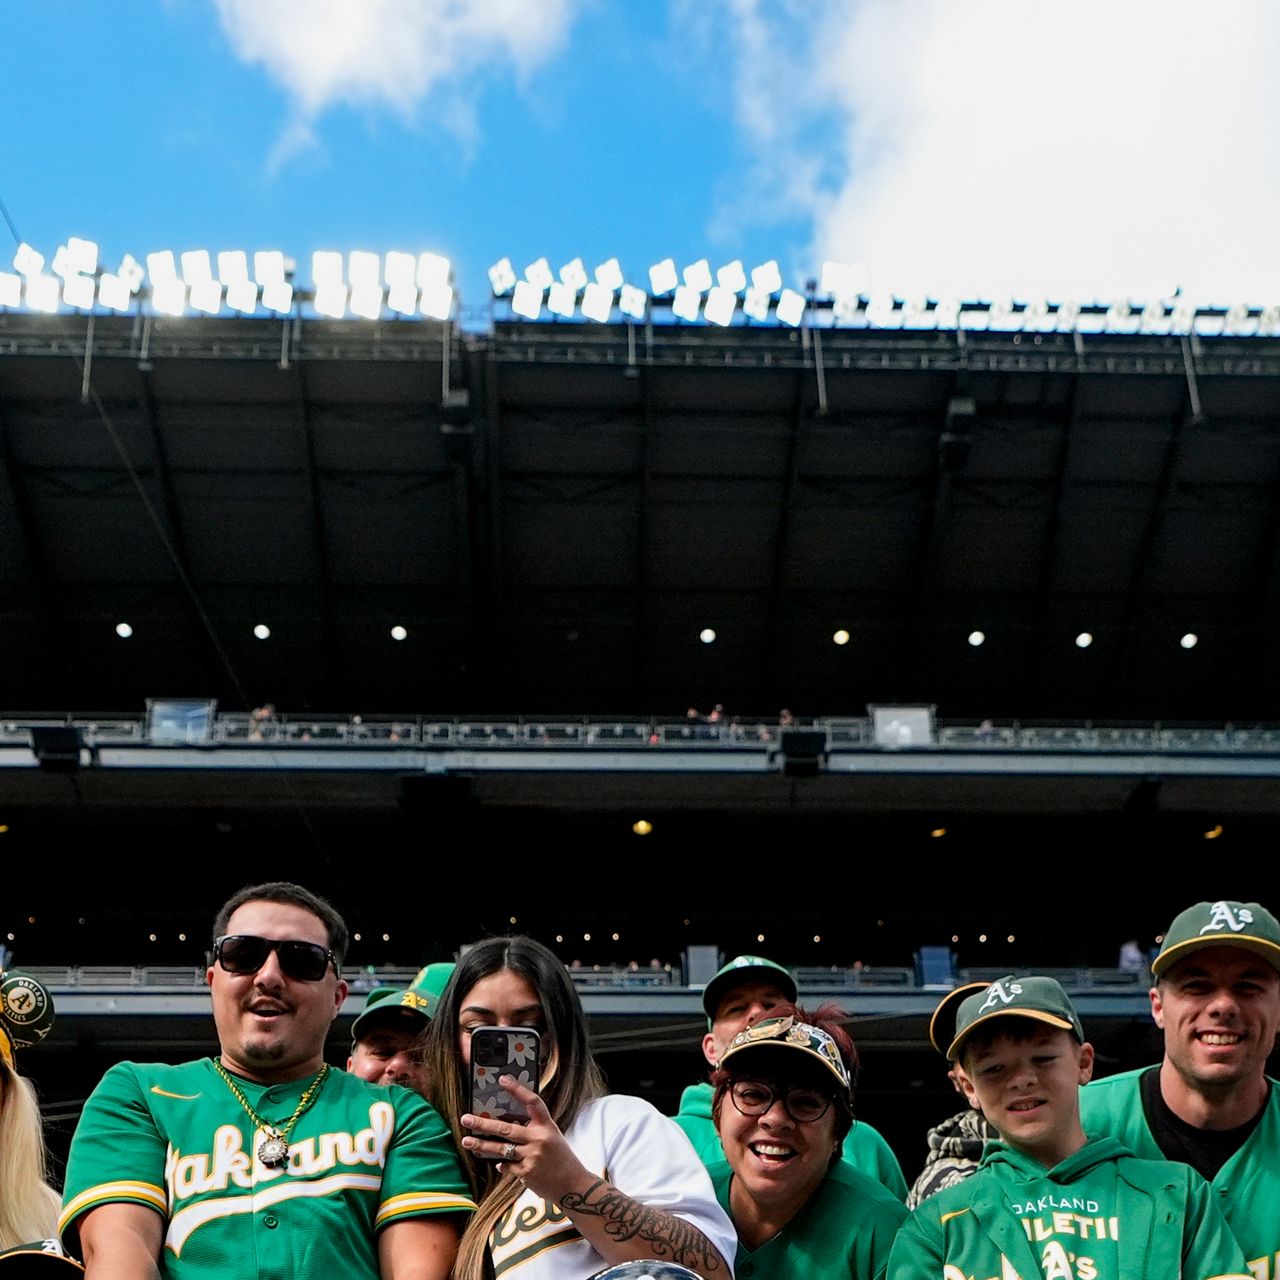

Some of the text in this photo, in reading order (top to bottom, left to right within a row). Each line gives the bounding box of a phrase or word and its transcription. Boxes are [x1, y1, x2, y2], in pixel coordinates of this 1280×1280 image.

[1199, 900, 1254, 936] A's
[977, 981, 1024, 1014] A's
[165, 1100, 395, 1215] akland
